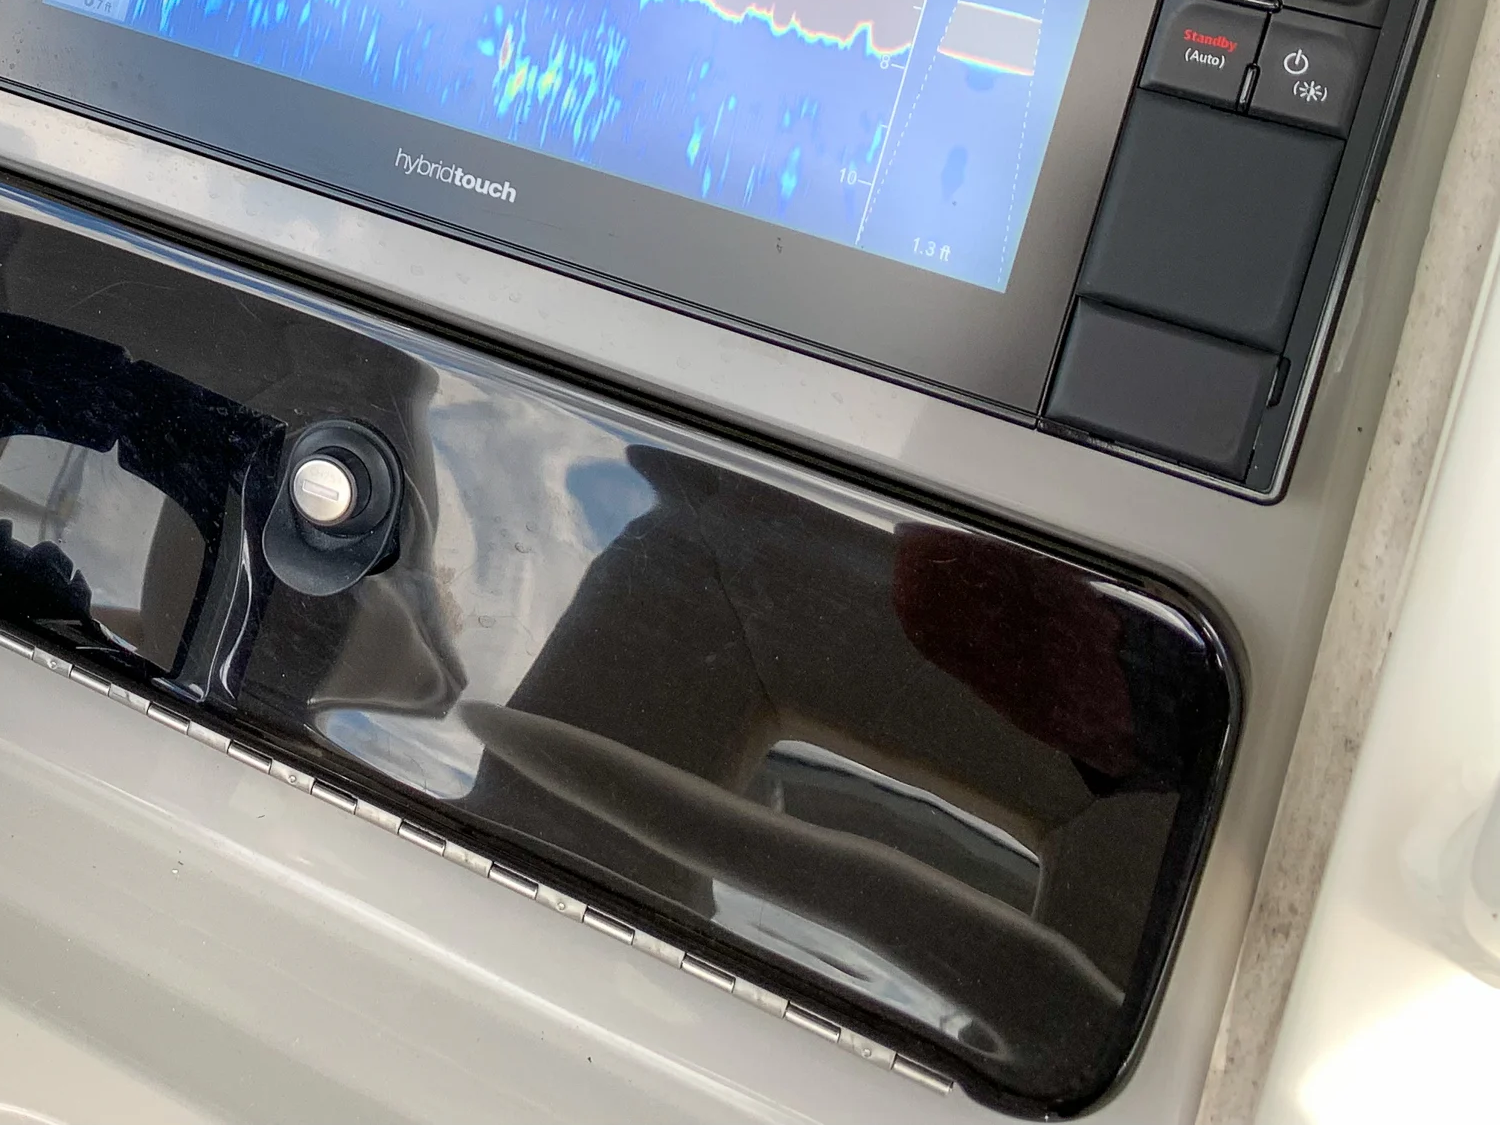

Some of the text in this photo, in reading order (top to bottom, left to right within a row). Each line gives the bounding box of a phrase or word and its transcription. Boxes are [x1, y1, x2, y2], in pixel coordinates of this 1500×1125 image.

[1183, 27, 1238, 52] Standby
[879, 54, 891, 69] 8
[1184, 46, 1226, 69] (Auto)
[395, 147, 517, 204] hybridtouch
[840, 170, 858, 186] 10
[912, 238, 952, 262] 1.3 ft
